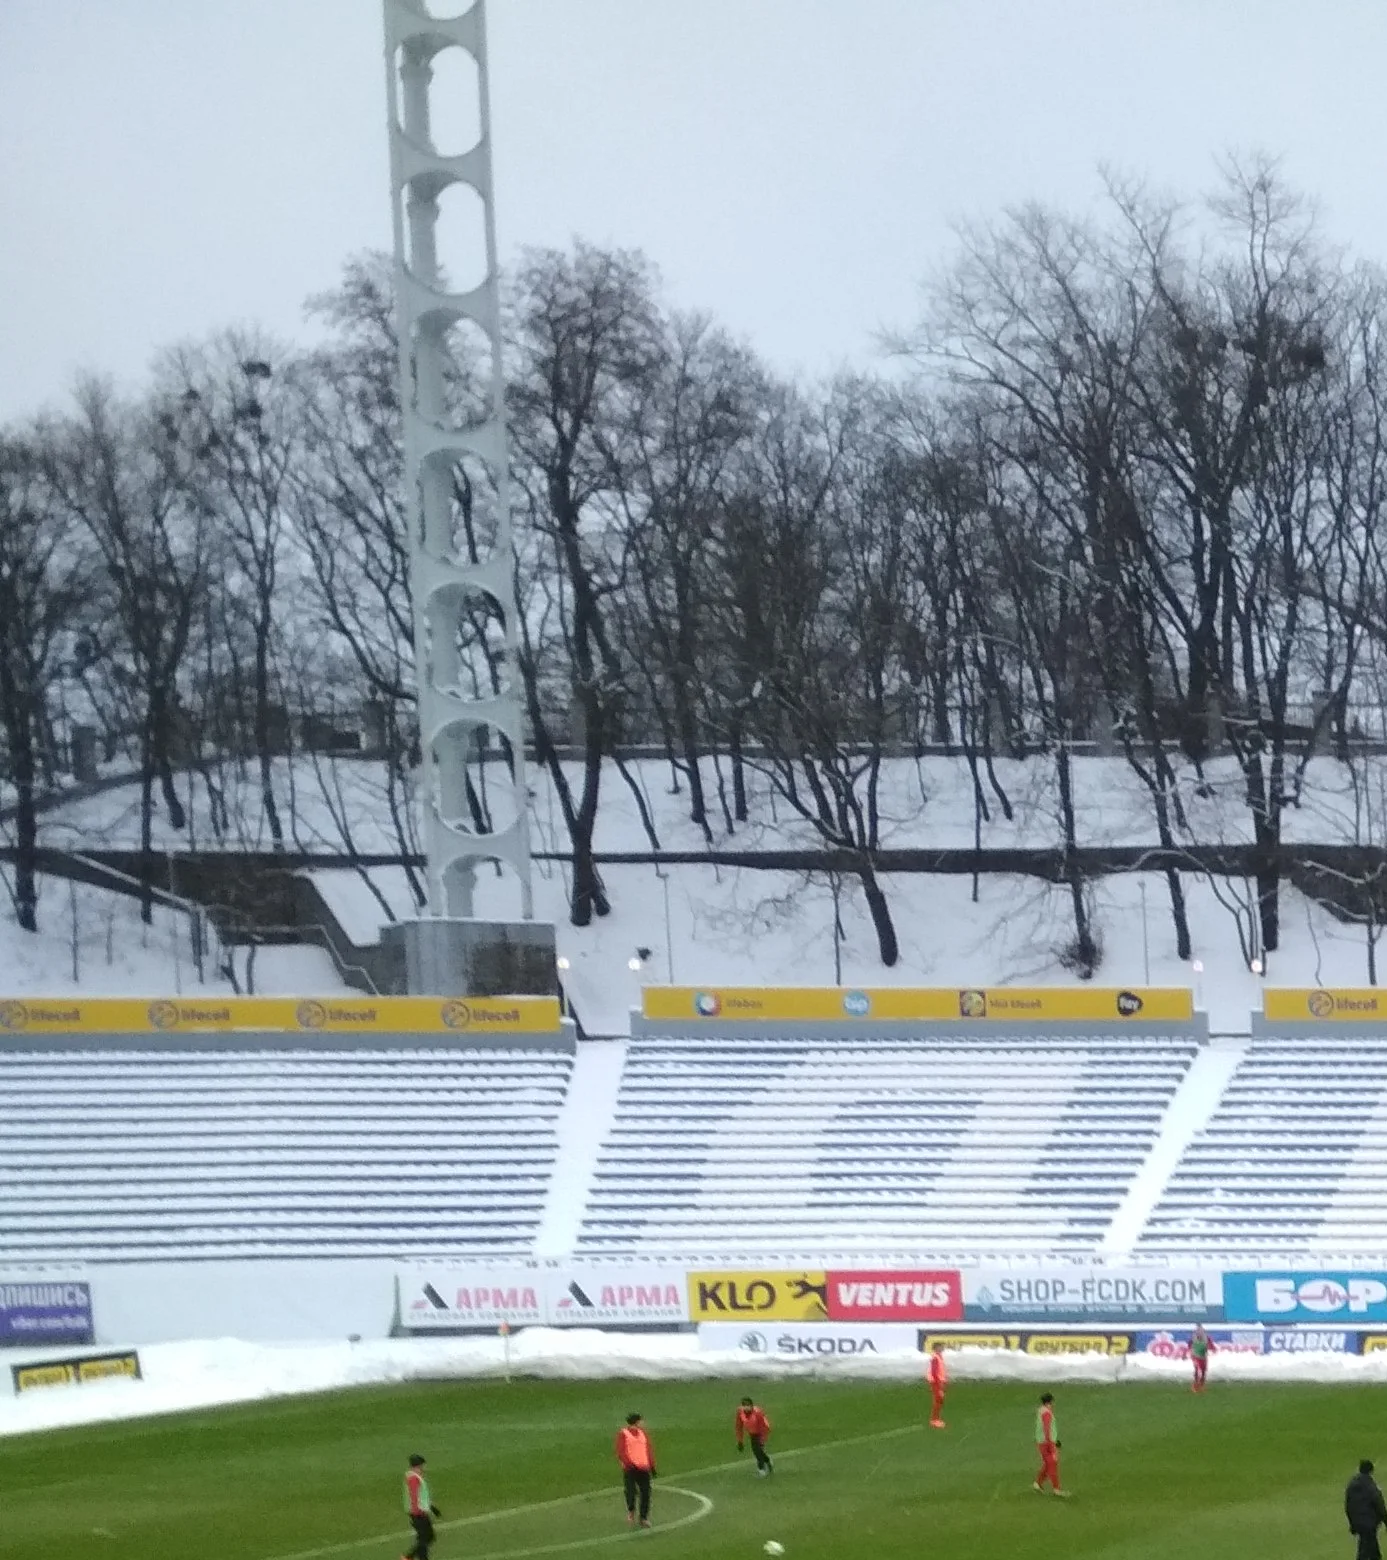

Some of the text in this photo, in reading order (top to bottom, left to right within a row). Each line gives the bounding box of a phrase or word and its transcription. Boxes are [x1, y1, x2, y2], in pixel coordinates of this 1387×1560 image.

[1336, 998, 1377, 1010] lifecell
[455, 1286, 538, 1309] АРМА
[600, 1284, 681, 1307] АРМА
[698, 1280, 776, 1310] KLO
[838, 1281, 951, 1307] VENTUS
[999, 1279, 1207, 1302] SHOP-FCDK.COM
[776, 1334, 878, 1354] ŠKODA
[1269, 1332, 1347, 1351] СТАВКИ
